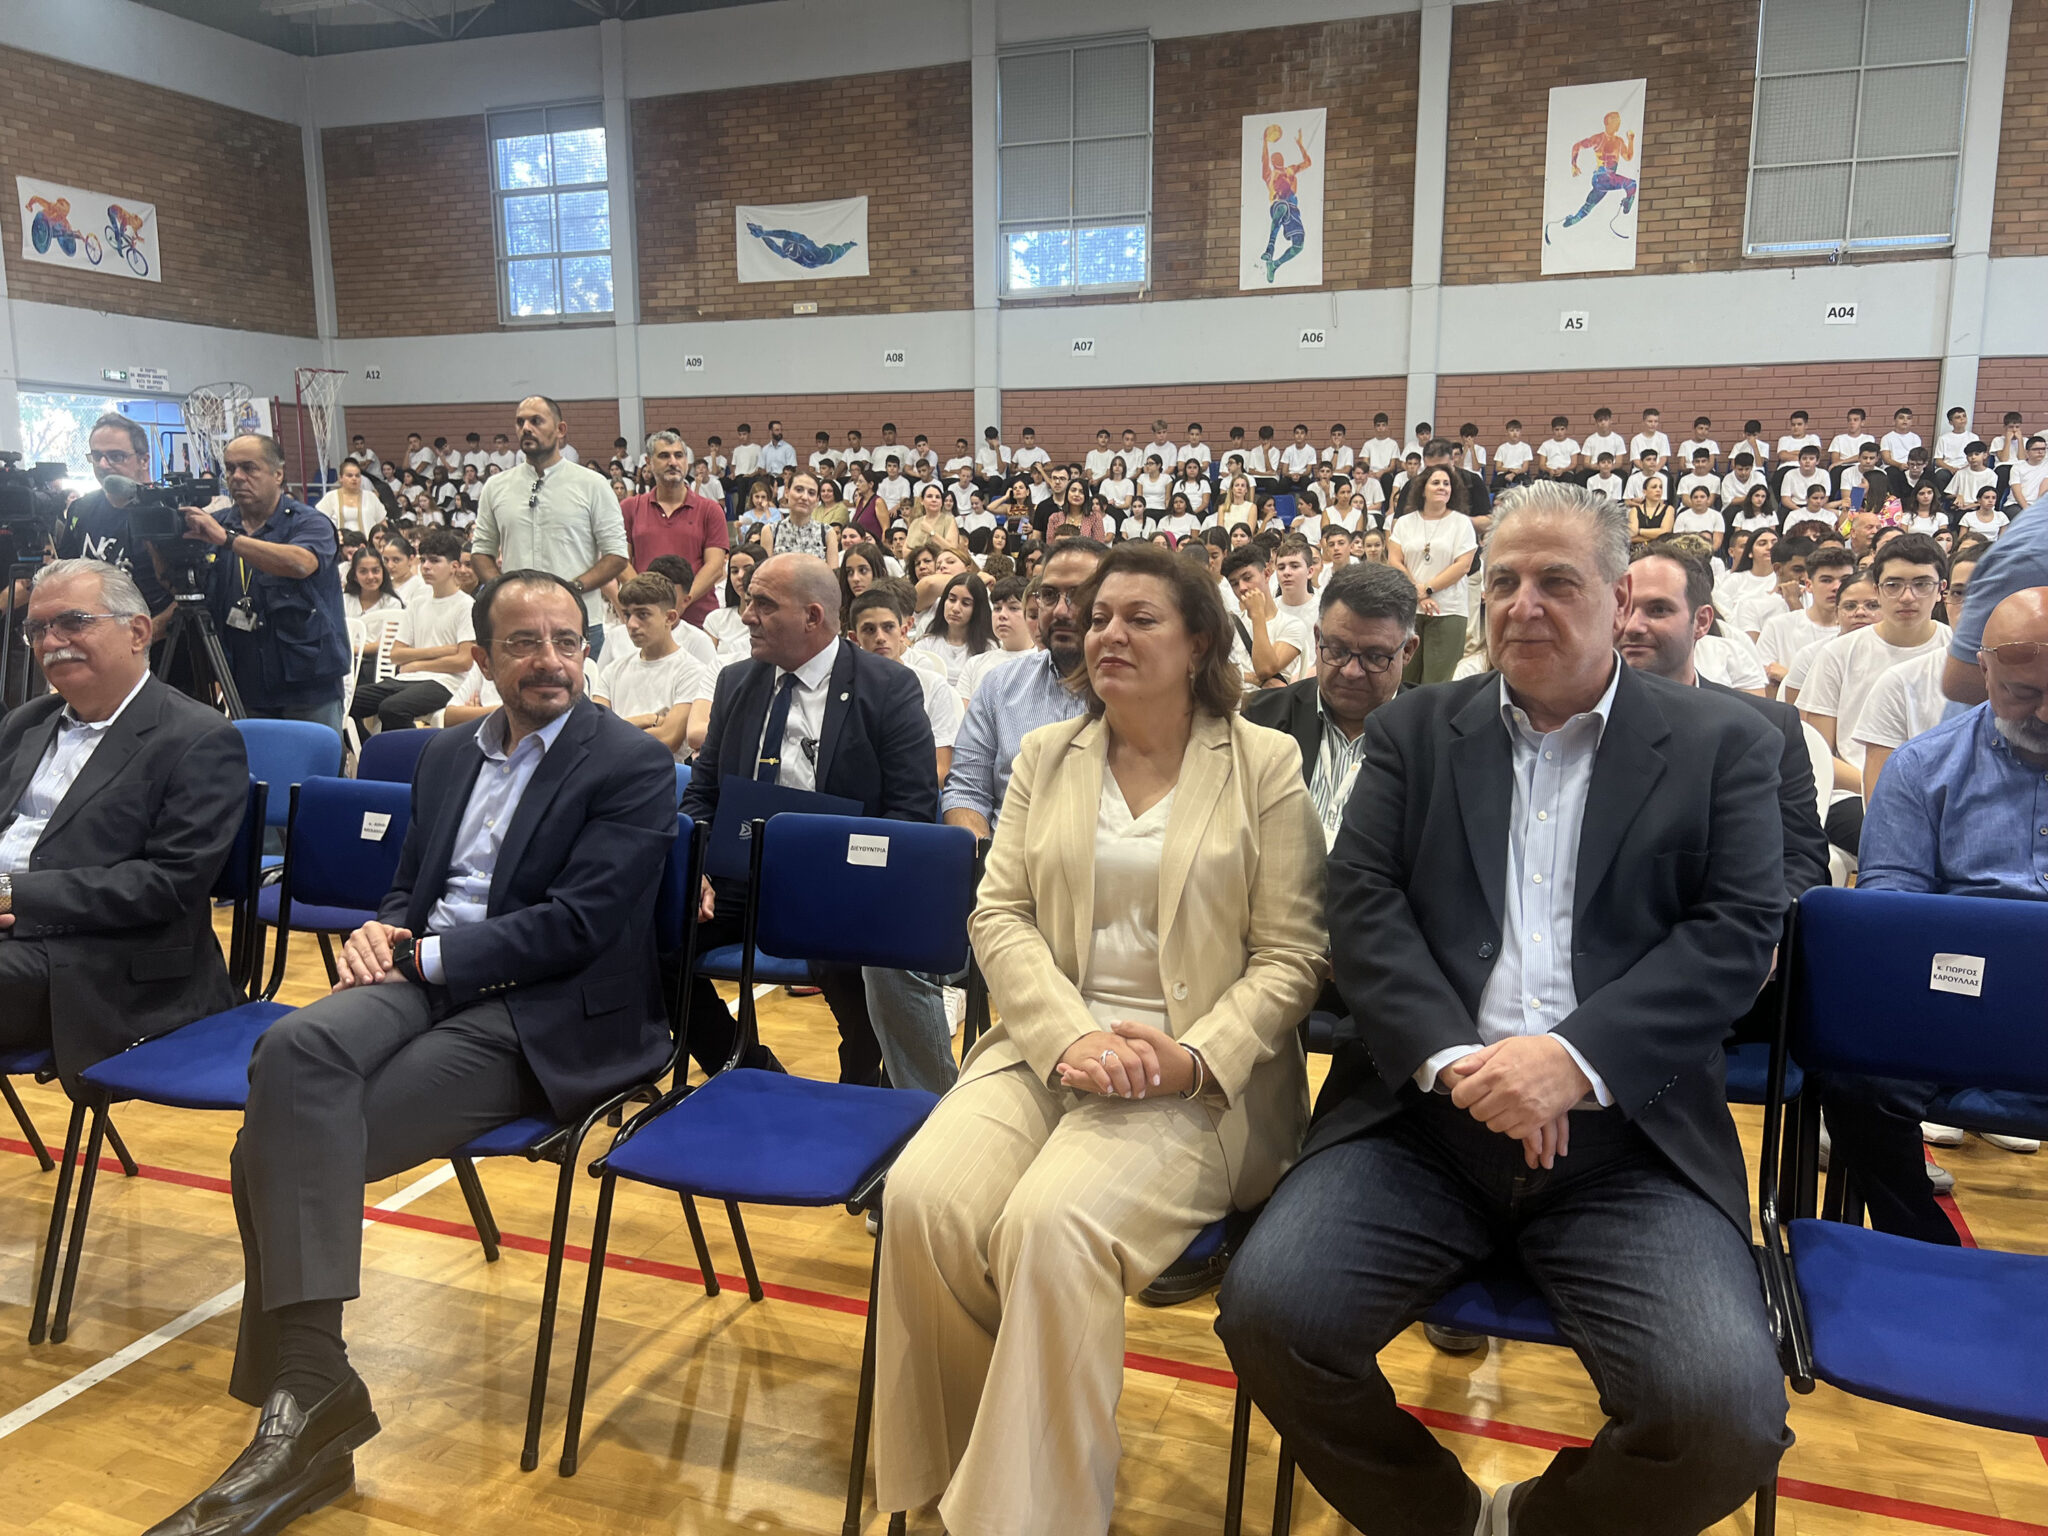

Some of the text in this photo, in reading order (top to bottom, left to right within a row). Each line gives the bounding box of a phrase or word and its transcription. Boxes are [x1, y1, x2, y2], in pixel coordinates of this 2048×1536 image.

[1827, 306, 1855, 318] A04
[1564, 317, 1583, 330] A5
[1301, 332, 1323, 343] A06
[1073, 341, 1093, 351] A07
[686, 358, 702, 367] A09
[886, 353, 903, 362] A08
[366, 370, 381, 380] A12
[1933, 973, 1979, 987] ΚΑΡΟΥΛΛΑΣ
